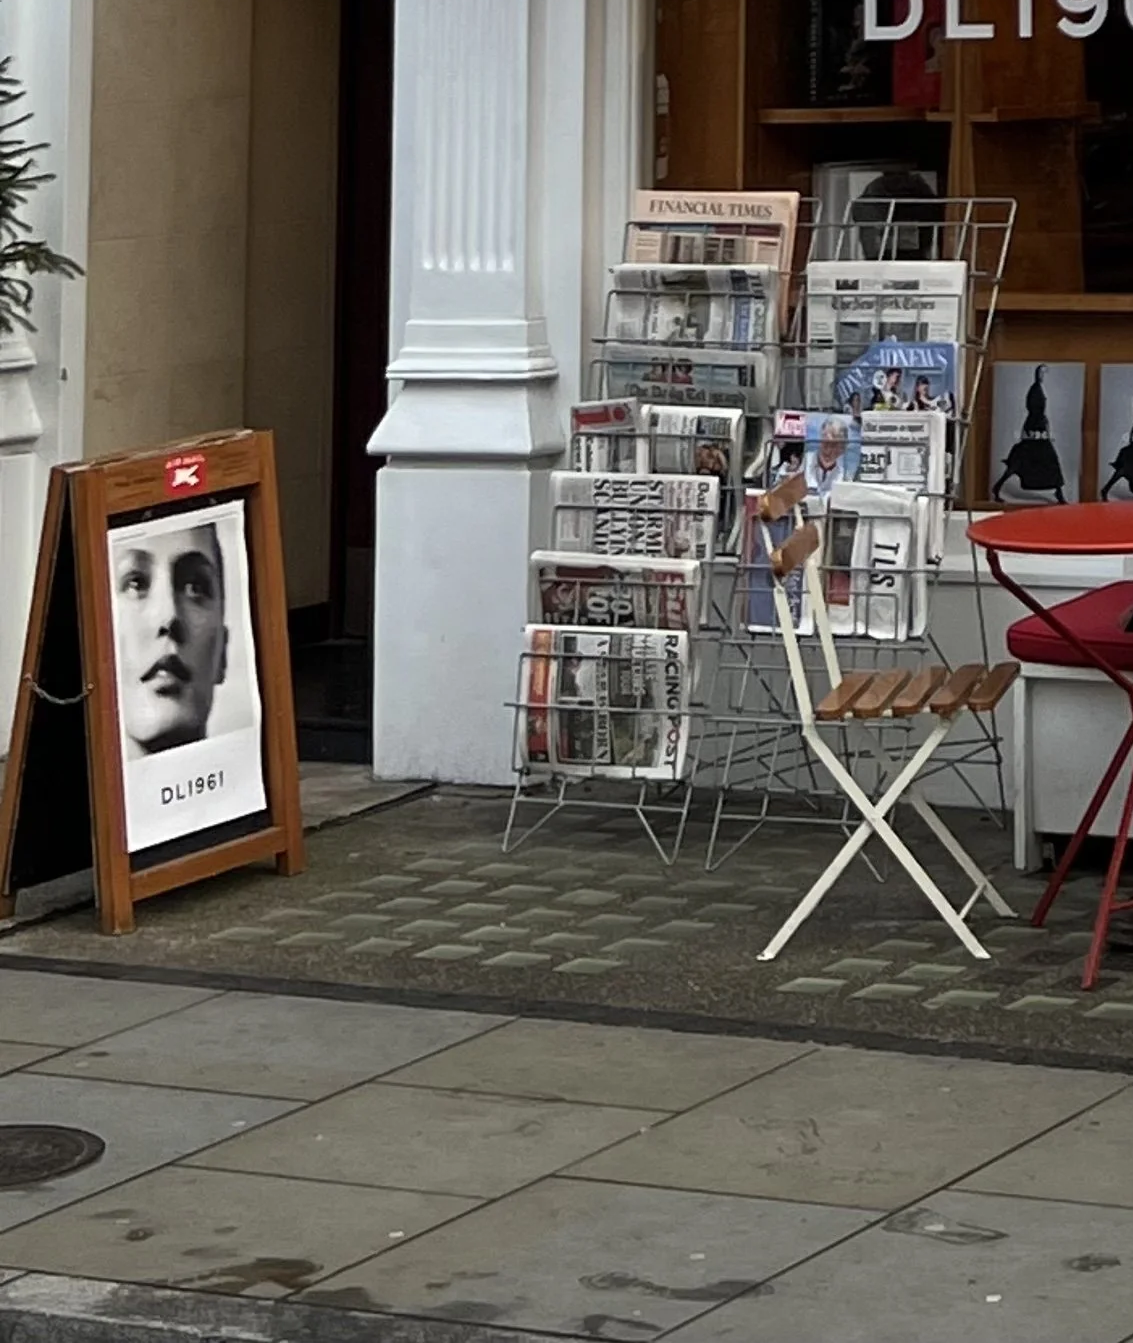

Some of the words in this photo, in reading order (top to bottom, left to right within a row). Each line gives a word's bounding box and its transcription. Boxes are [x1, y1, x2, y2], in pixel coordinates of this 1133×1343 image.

[650, 199, 724, 216] FINANCIAL
[728, 203, 772, 218] TIMES
[869, 542, 900, 588] TLS
[665, 634, 680, 710] RACING
[664, 713, 682, 767] POST
[161, 770, 223, 804] DL1961
